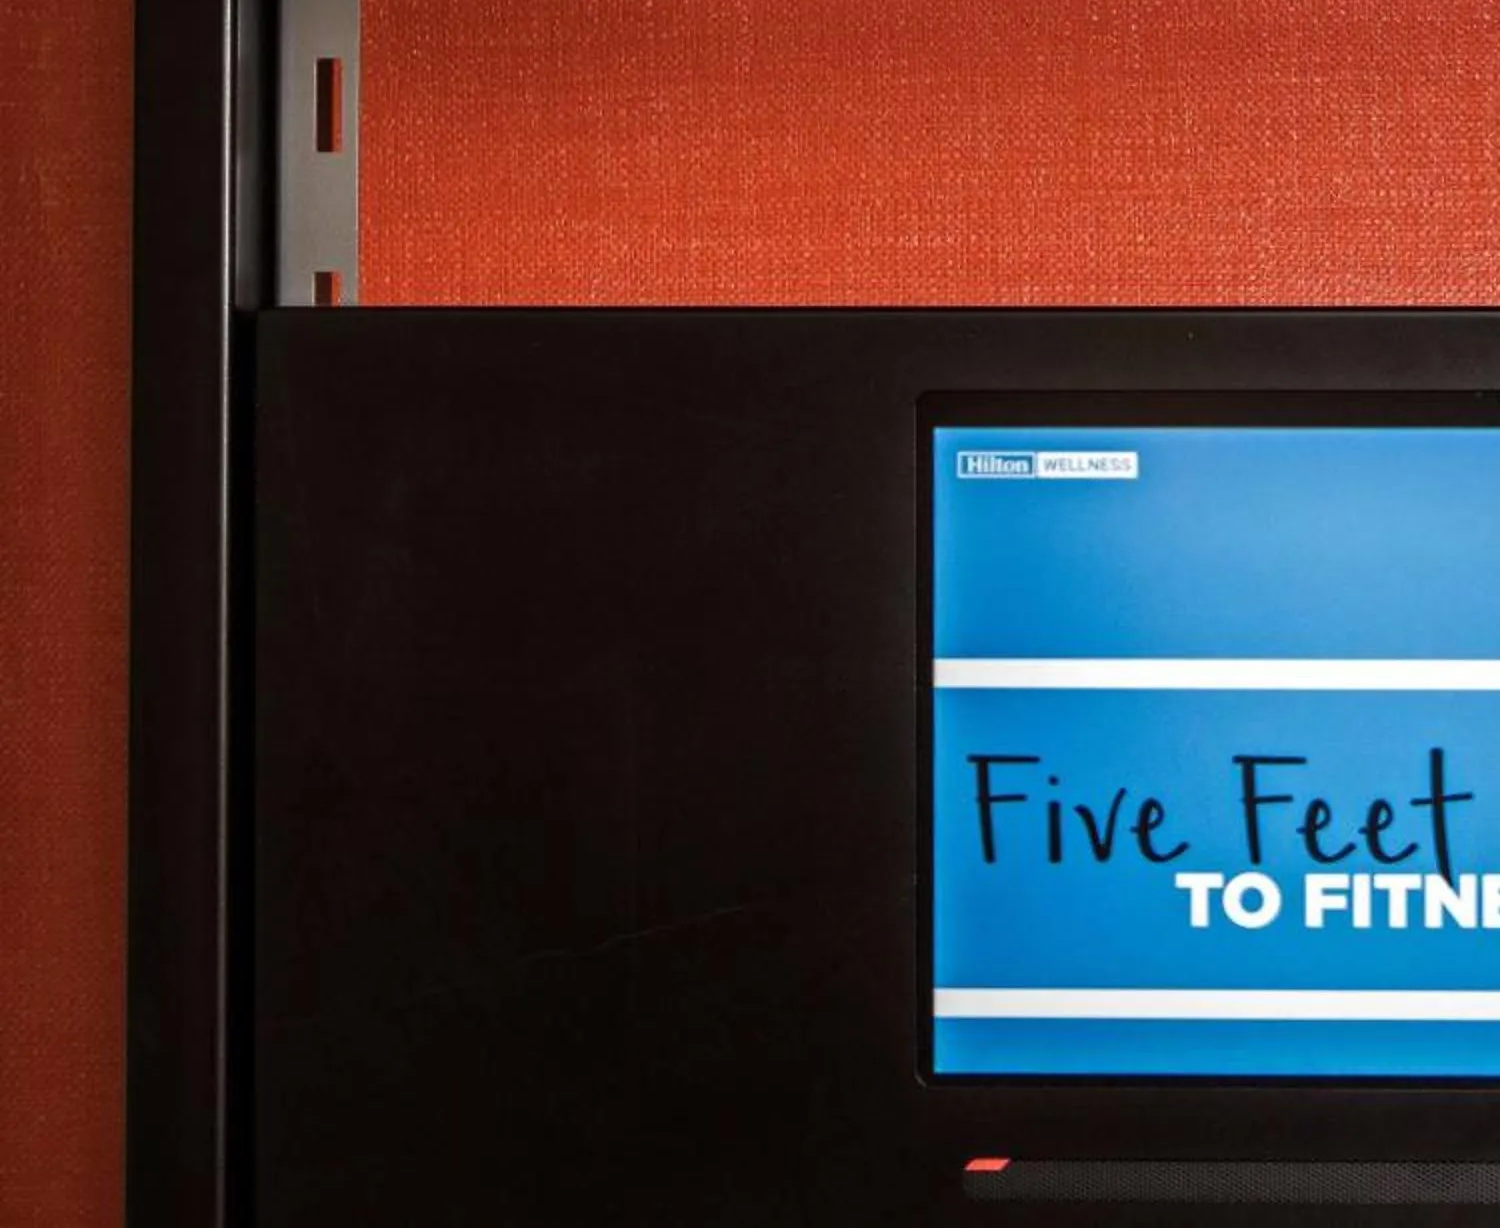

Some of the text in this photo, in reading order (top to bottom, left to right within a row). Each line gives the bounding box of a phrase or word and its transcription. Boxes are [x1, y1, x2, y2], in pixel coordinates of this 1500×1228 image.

[965, 456, 1133, 473] Hilton WELLNESS
[966, 747, 1475, 882] Five Feet
[1174, 871, 1282, 929] TO
